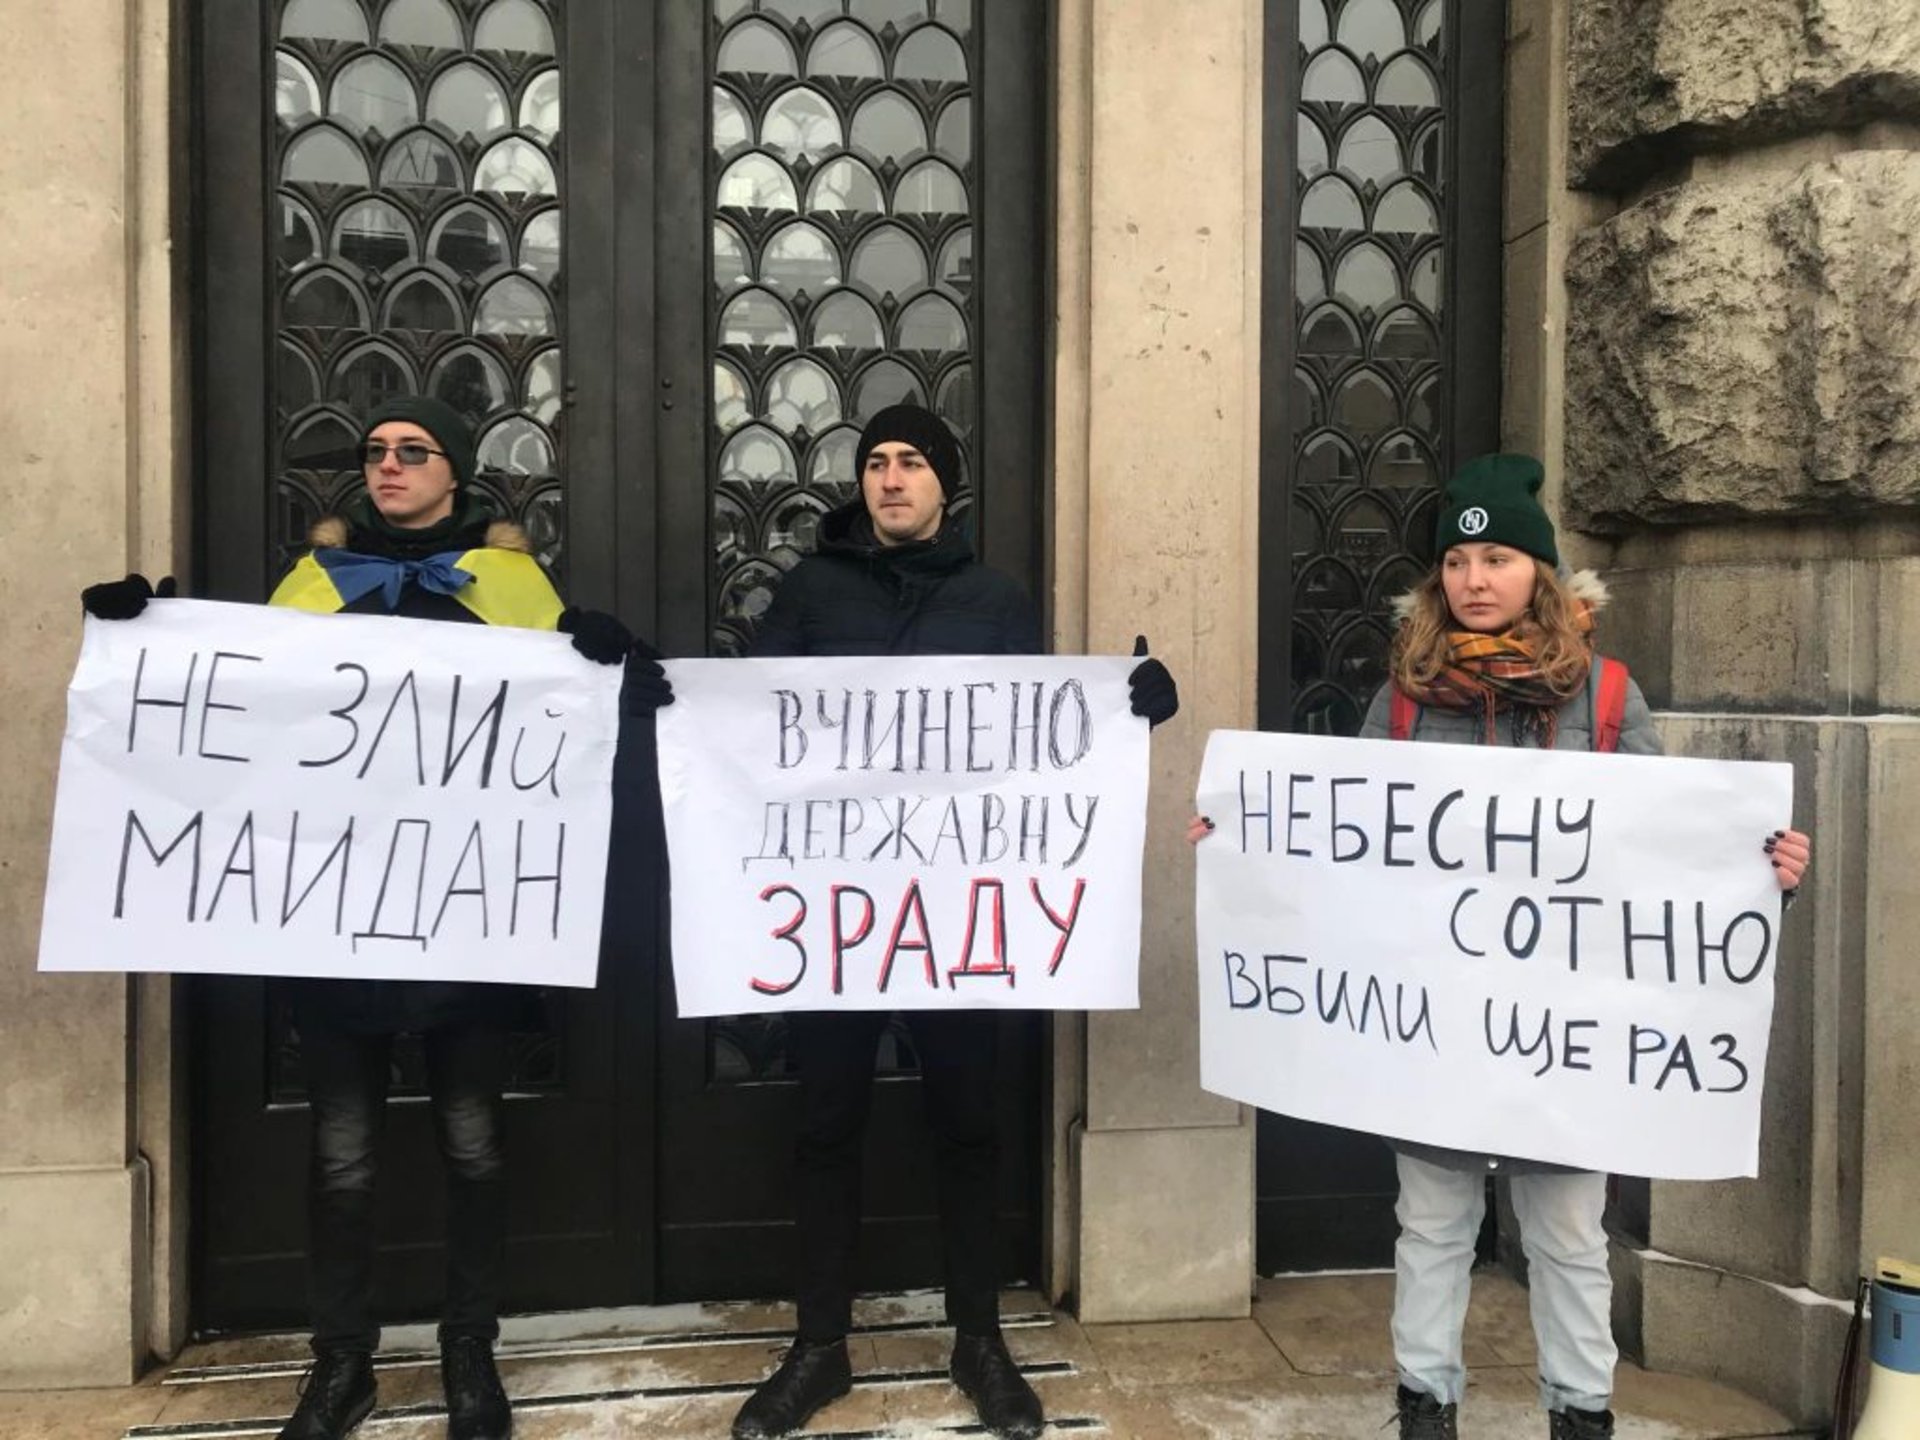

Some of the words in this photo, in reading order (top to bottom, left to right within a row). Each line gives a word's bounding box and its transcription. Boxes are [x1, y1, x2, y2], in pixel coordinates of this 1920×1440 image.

[128, 648, 263, 763] НЕ
[770, 678, 1094, 773] ВЧИНЕНО
[742, 793, 1100, 873] ДЕРЖАВНУ
[1240, 769, 1595, 884] НЕБЕСНУ
[750, 877, 1087, 996] ЗРАДУ
[1450, 888, 1771, 985] СОТНЮ
[1223, 950, 1438, 1054] ВБИЛИ
[1484, 998, 1599, 1077] ЩЕ
[1628, 1024, 1749, 1093] РАЗ
